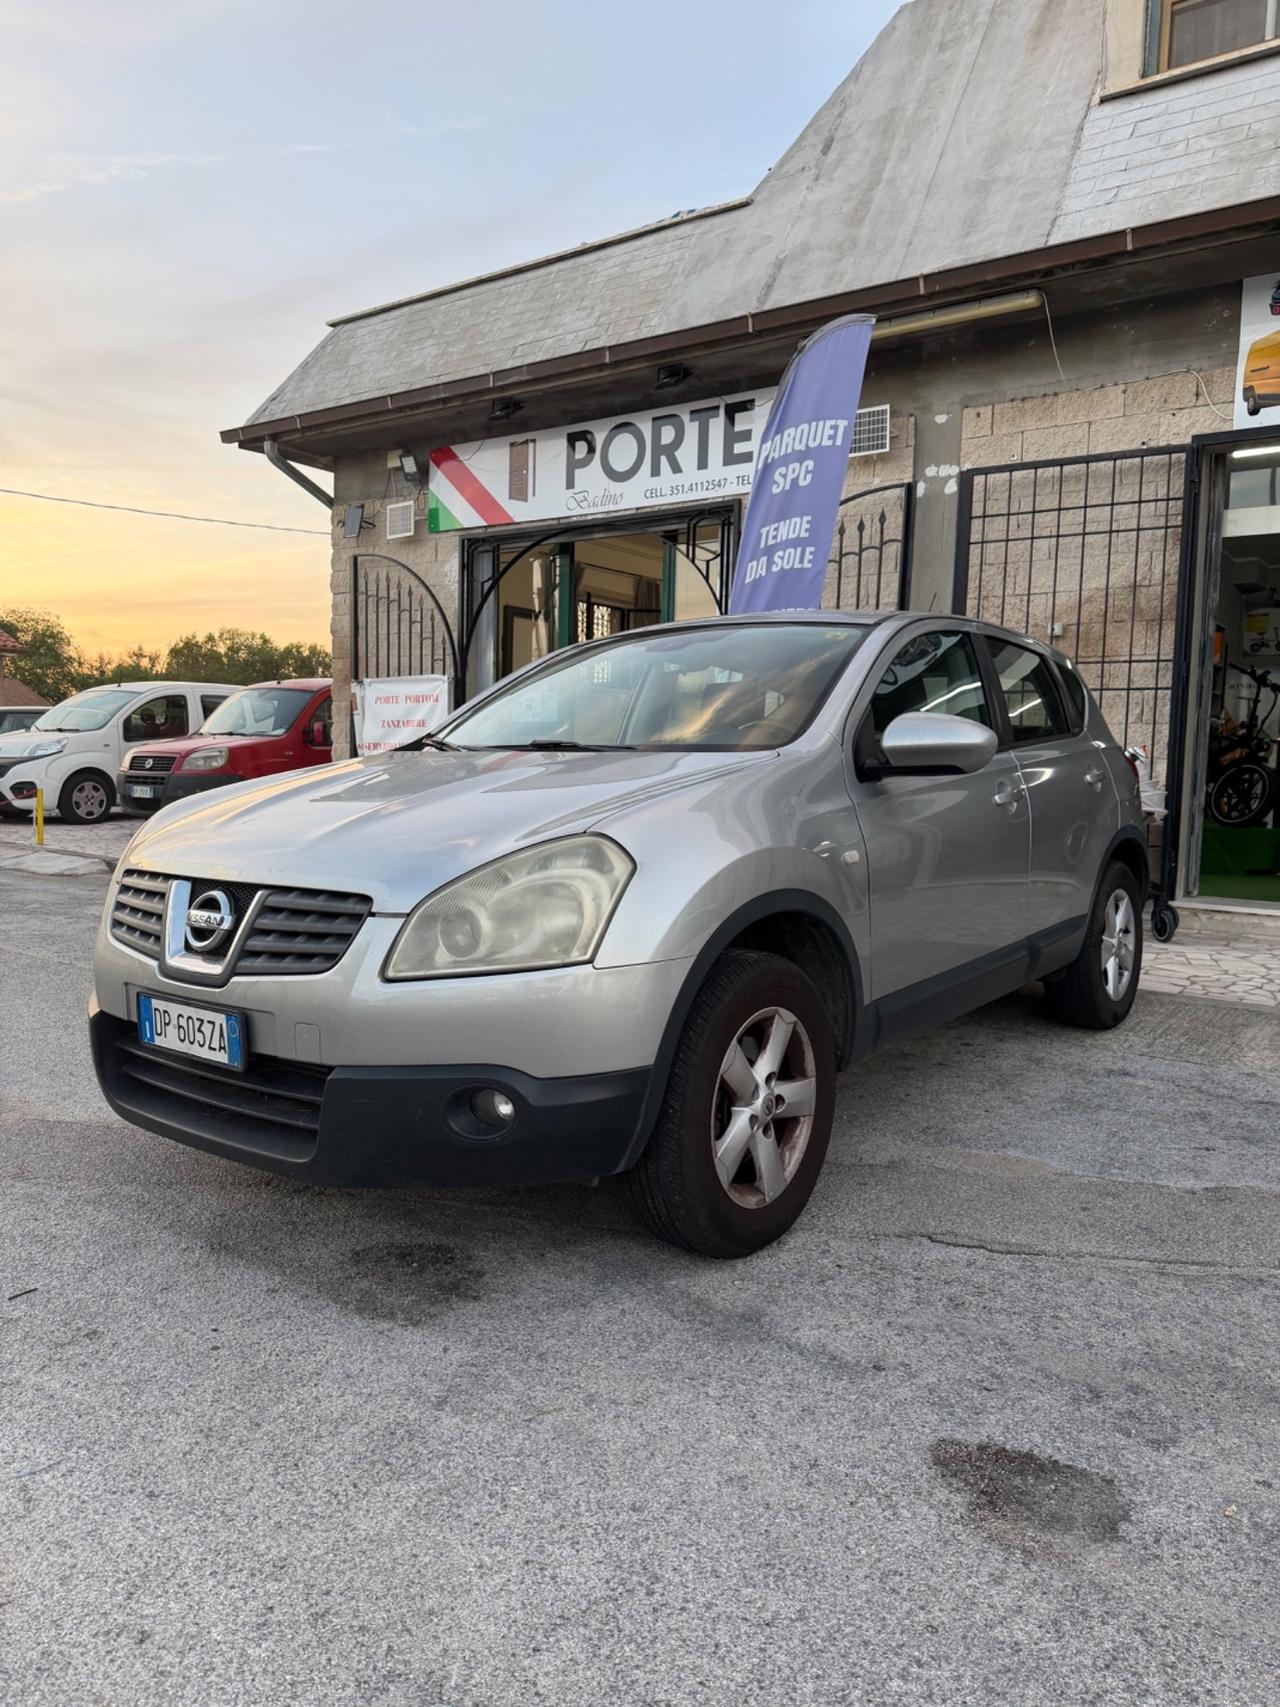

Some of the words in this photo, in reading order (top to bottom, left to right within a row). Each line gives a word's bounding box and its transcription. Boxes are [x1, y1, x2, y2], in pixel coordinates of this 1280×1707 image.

[565, 398, 756, 490] PORTE
[758, 419, 848, 469] PARQUET
[643, 488, 668, 500] CELL.
[669, 478, 728, 497] 351.4112547
[771, 459, 815, 495] SPC
[565, 487, 625, 512] Badino
[759, 515, 812, 549] TENDE
[744, 558, 768, 585] DA
[771, 546, 815, 574] SOLE
[153, 1006, 171, 1039] DP
[177, 1012, 228, 1055] 603ZA
